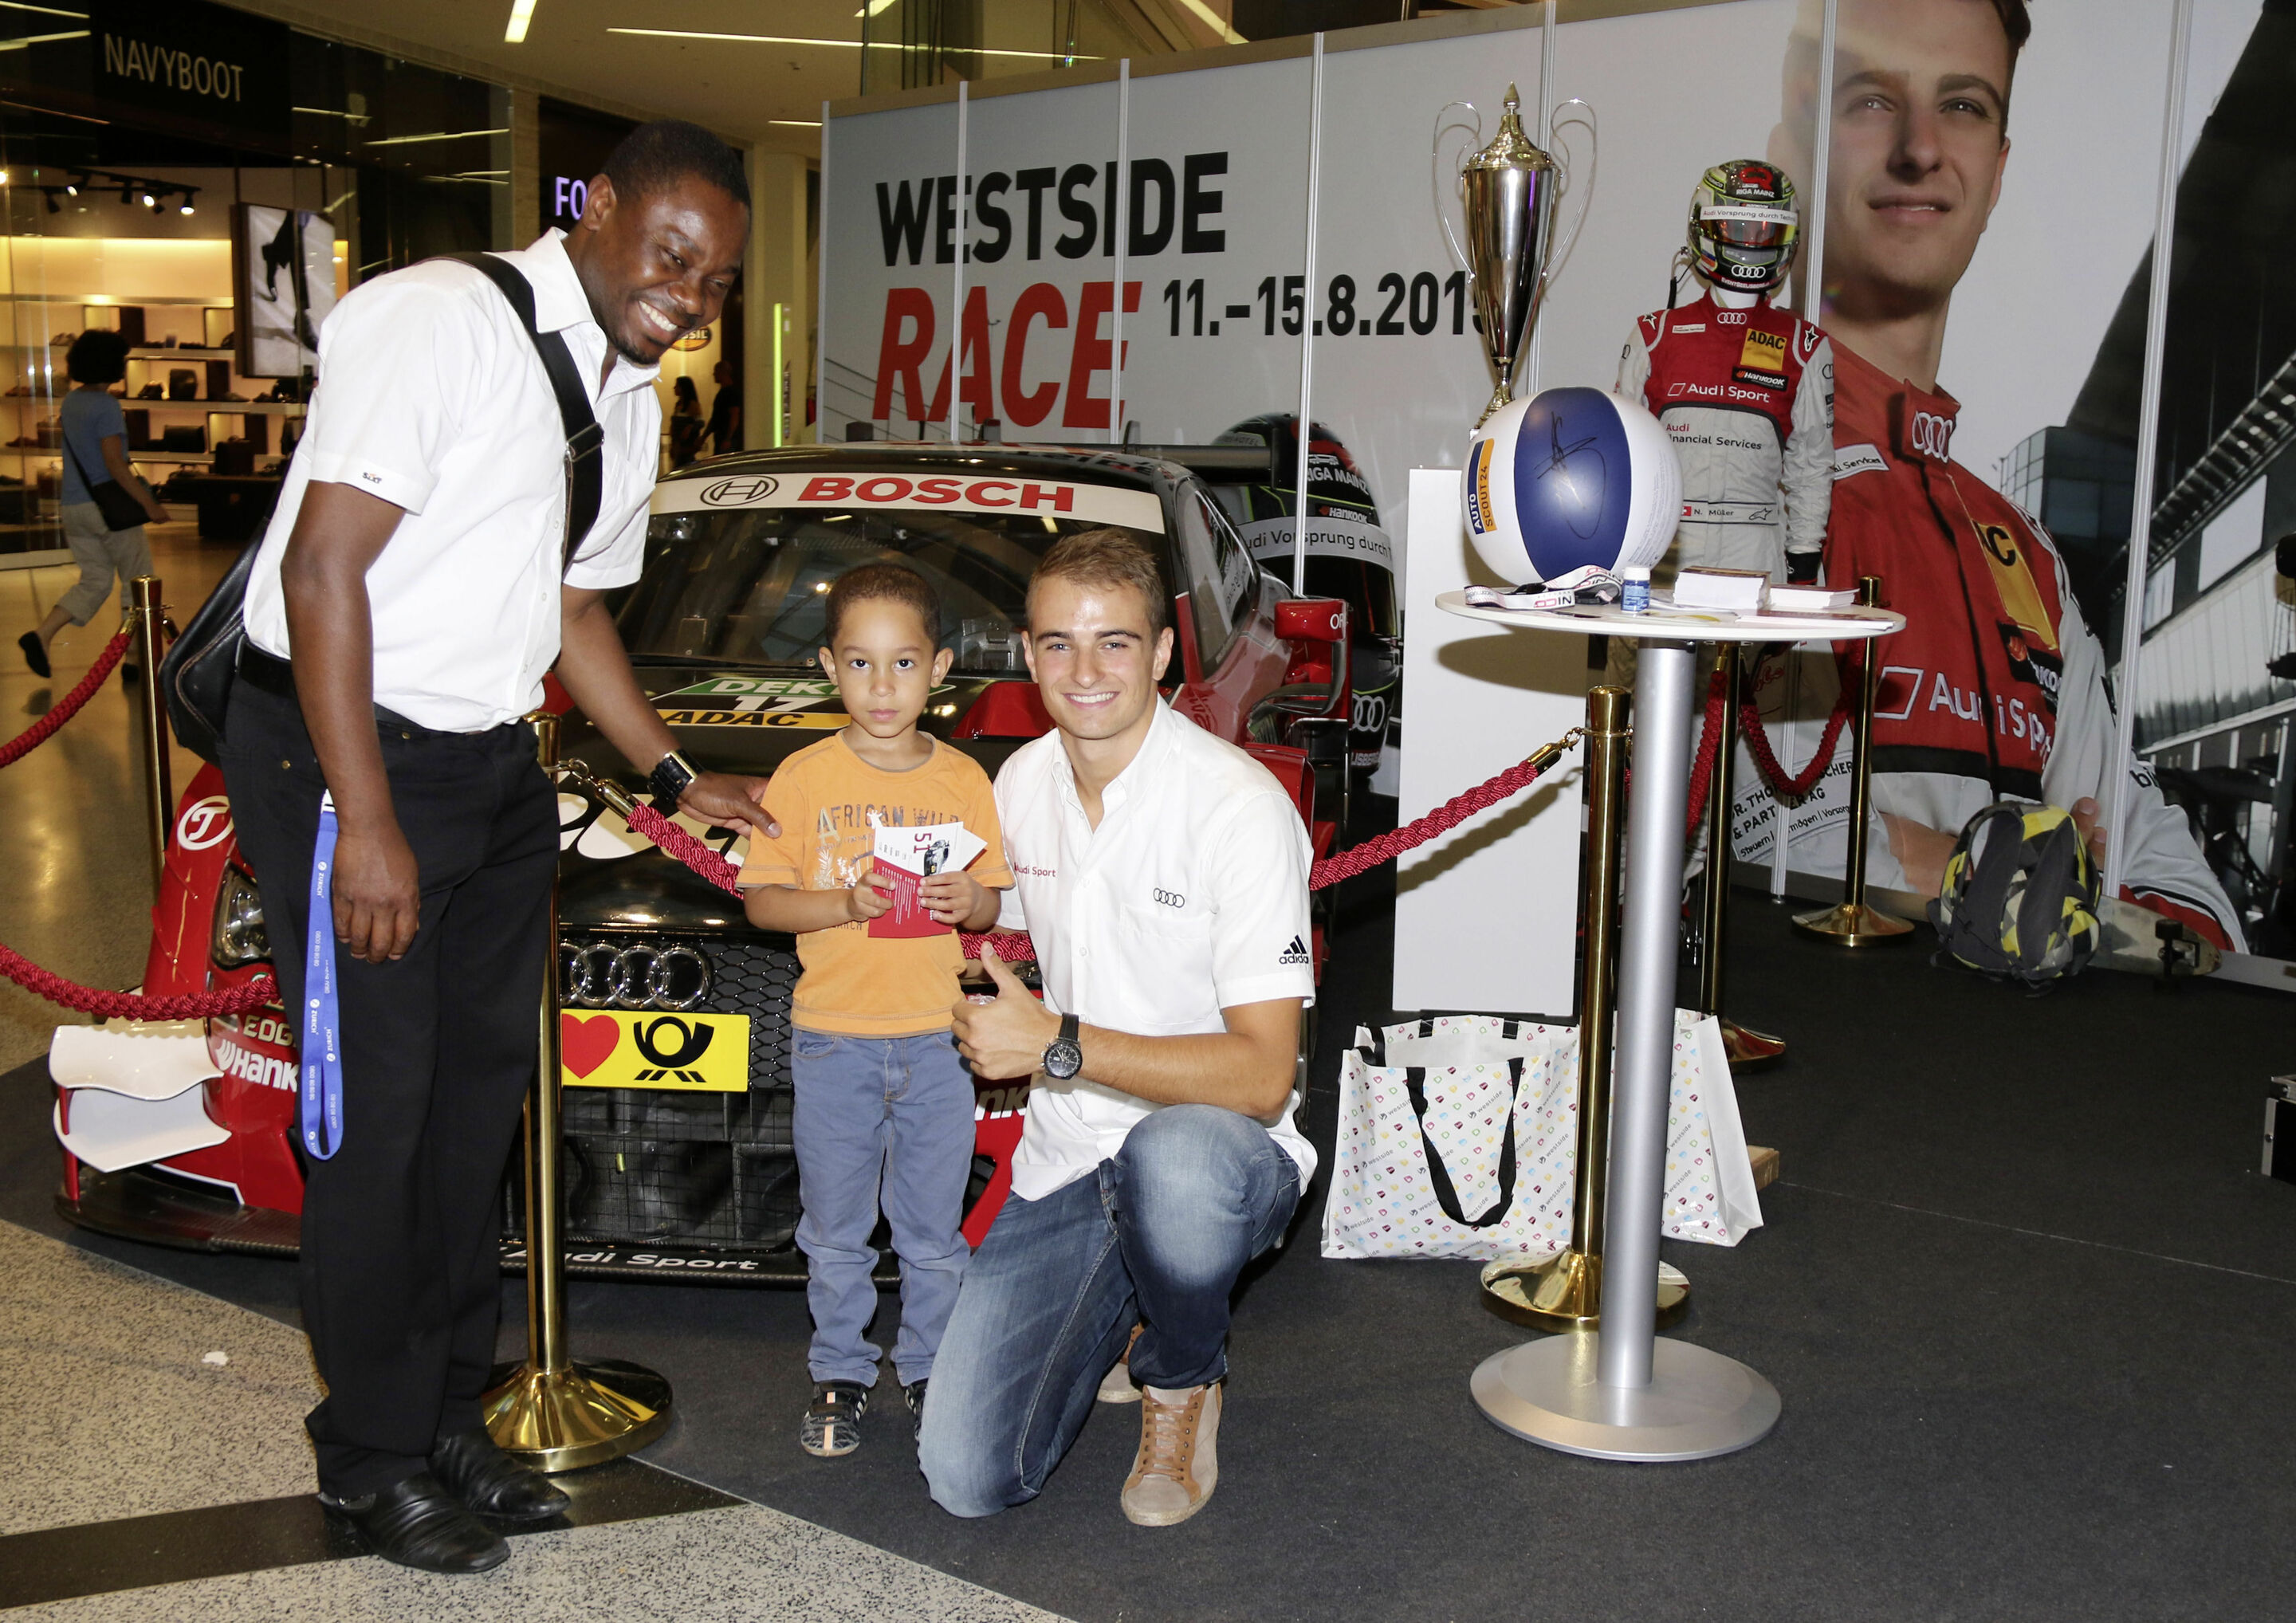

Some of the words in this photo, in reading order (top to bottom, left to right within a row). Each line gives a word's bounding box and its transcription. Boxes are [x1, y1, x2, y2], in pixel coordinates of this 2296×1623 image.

[104, 33, 243, 101] NAVYBOOT
[1754, 189, 1775, 198] MAINZ
[876, 151, 1228, 267] WESTSIDE
[1718, 210, 1756, 218] Vorsprung
[1748, 331, 1785, 350] ADAC
[872, 281, 1142, 430] RACE
[1687, 383, 1725, 396] Audi
[1728, 387, 1771, 403] Sport
[1666, 423, 1689, 432] Audi
[1670, 434, 1712, 445] inancial
[1716, 437, 1763, 450] Services
[1335, 470, 1370, 495] MAINZ
[797, 477, 1075, 513] BOSCH
[1480, 485, 1493, 527] SCOUT
[1469, 493, 1482, 529] AUTO
[1248, 532, 1267, 549] udi
[1271, 529, 1355, 549] Vosprung
[1359, 535, 1389, 557] durch
[733, 696, 831, 712] 17
[665, 711, 804, 726] ADAC
[816, 804, 904, 835] AFRICAN
[1733, 827, 1743, 840] &
[1810, 788, 1826, 802] AG
[914, 833, 932, 854] 51
[1032, 867, 1056, 878] Sport
[243, 1014, 296, 1047] EDG
[1477, 1091, 1503, 1113] westside
[1545, 1133, 1569, 1157] westside
[1670, 1123, 1692, 1148] westside
[1368, 1149, 1394, 1166] westside
[1669, 1169, 1692, 1193] westside
[1545, 1181, 1567, 1205] westside
[1466, 1197, 1489, 1220] westside
[1350, 1216, 1374, 1230] westside
[627, 1254, 758, 1271] Sport
